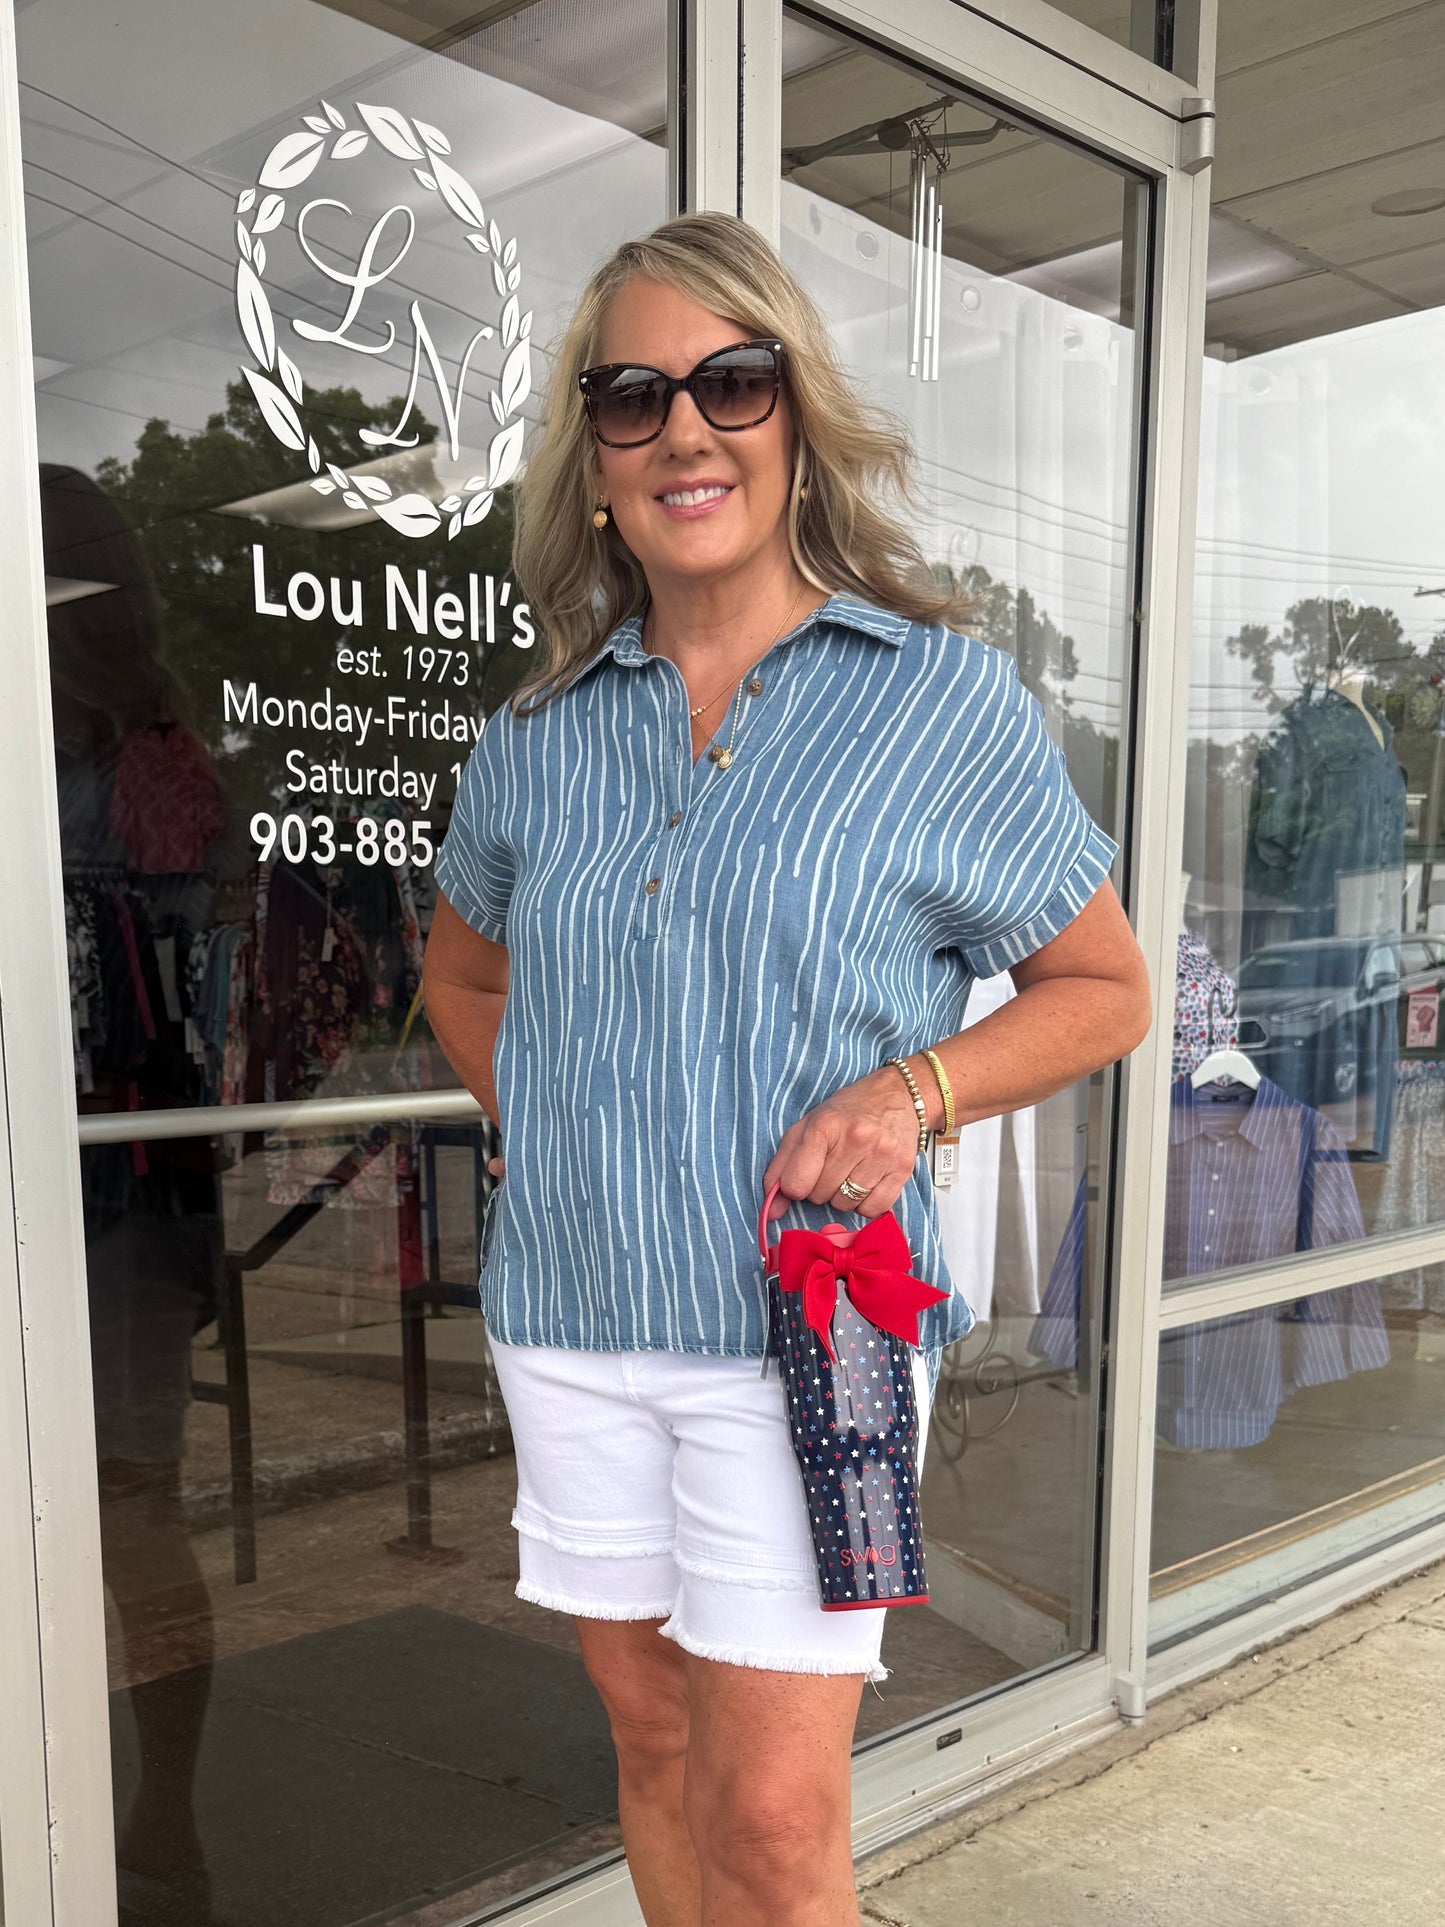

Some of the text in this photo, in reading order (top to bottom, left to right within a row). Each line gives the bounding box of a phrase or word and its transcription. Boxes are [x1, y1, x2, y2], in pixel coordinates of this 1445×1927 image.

[293, 199, 415, 354] L
[359, 300, 493, 462] N
[252, 544, 536, 649] Lou Nell's
[336, 646, 469, 686] est. 1973
[222, 679, 487, 753] Monday-Friday
[285, 749, 437, 811] Saturday
[840, 1541, 896, 1566] swig
